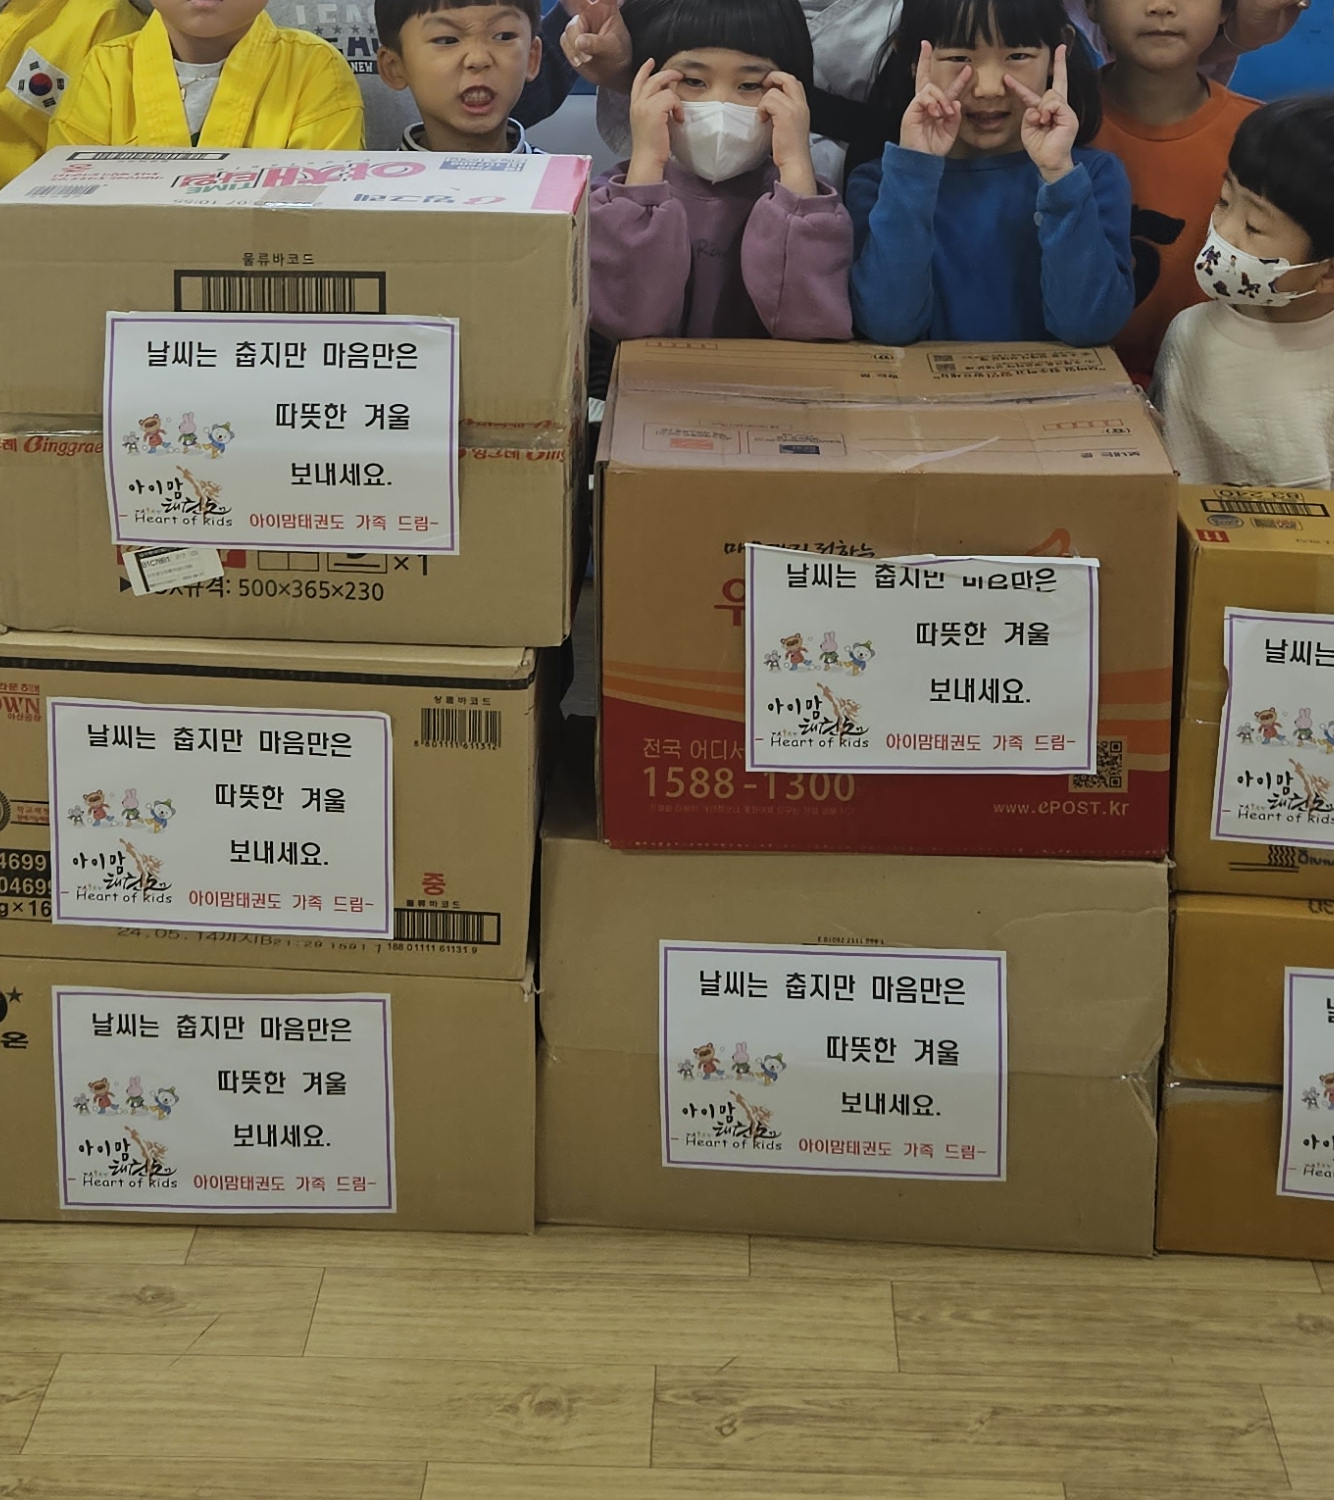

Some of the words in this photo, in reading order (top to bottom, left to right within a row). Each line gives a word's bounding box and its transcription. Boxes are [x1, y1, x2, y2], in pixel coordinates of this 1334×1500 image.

[350, 61, 373, 73] NEW
[190, 182, 250, 195] TIME
[242, 251, 316, 267] 물류바코드
[148, 341, 217, 367] 날씨는
[235, 341, 307, 368] 춥지만
[324, 342, 418, 369] 마음만은
[276, 403, 347, 429] 따뜻한
[365, 404, 410, 430] 겨울
[291, 463, 392, 486] 보내세요.
[129, 477, 183, 500] 아이맘
[135, 513, 179, 525] Heart
[183, 516, 198, 526] of
[203, 514, 232, 527] kids
[250, 514, 344, 529] 아이맘태권도
[356, 515, 386, 530] 가족
[787, 563, 857, 588] 날씨는
[917, 621, 987, 646] 따뜻한
[1004, 622, 1050, 646] 겨울
[930, 678, 1030, 703] 보내세요.
[768, 697, 822, 721] 아이맘
[88, 724, 156, 749] 날씨는
[174, 727, 243, 752] 춥지만
[260, 730, 352, 757] 마음만은
[643, 738, 682, 760] 전국
[771, 735, 813, 748] Heart
[819, 735, 834, 748] of
[840, 734, 869, 749] kids
[886, 733, 981, 751] 아이맘태권도
[993, 735, 1022, 751] 가족
[643, 766, 856, 801] 1588-1300
[1237, 769, 1294, 795] 아이맘
[216, 784, 284, 810] 따뜻한
[301, 788, 346, 813] 겨울
[993, 800, 1130, 816] www.ePOST.kr
[1237, 809, 1281, 823] Heart
[1286, 811, 1304, 824] of
[72, 851, 126, 872] 아이맘
[230, 840, 328, 866] 보내세요.
[422, 872, 447, 896] 중
[76, 889, 118, 902] Heart
[124, 891, 138, 904] of
[143, 891, 172, 904] kids
[189, 890, 281, 909] 아이맘태권도
[293, 895, 322, 911] 가족
[406, 899, 462, 909] 물류바코드
[700, 970, 768, 998] 날씨는
[786, 972, 855, 1001] 춥지만
[873, 976, 965, 1005] 마음만은
[92, 1013, 159, 1038] 날씨는
[177, 1014, 245, 1039] 춥지만
[261, 1017, 352, 1042] 마음만은
[827, 1036, 897, 1063] 따뜻한
[914, 1039, 959, 1066] 겨울
[218, 1070, 286, 1094] 따뜻한
[303, 1072, 346, 1095] 겨울
[682, 1101, 735, 1122] 아이맘
[841, 1092, 941, 1116] 보내세요.
[234, 1124, 330, 1147] 보내세요.
[685, 1136, 728, 1148] Heart
[732, 1139, 748, 1150] of
[753, 1137, 782, 1151] kids
[78, 1138, 131, 1161] 아이맘
[799, 1139, 891, 1156] 아이맘태권도
[904, 1143, 933, 1158] 가족
[82, 1176, 124, 1187] Heart
[129, 1177, 143, 1188] of
[148, 1177, 177, 1189] kids
[194, 1175, 285, 1191] 아이맘태권도
[296, 1177, 325, 1191] 가족
